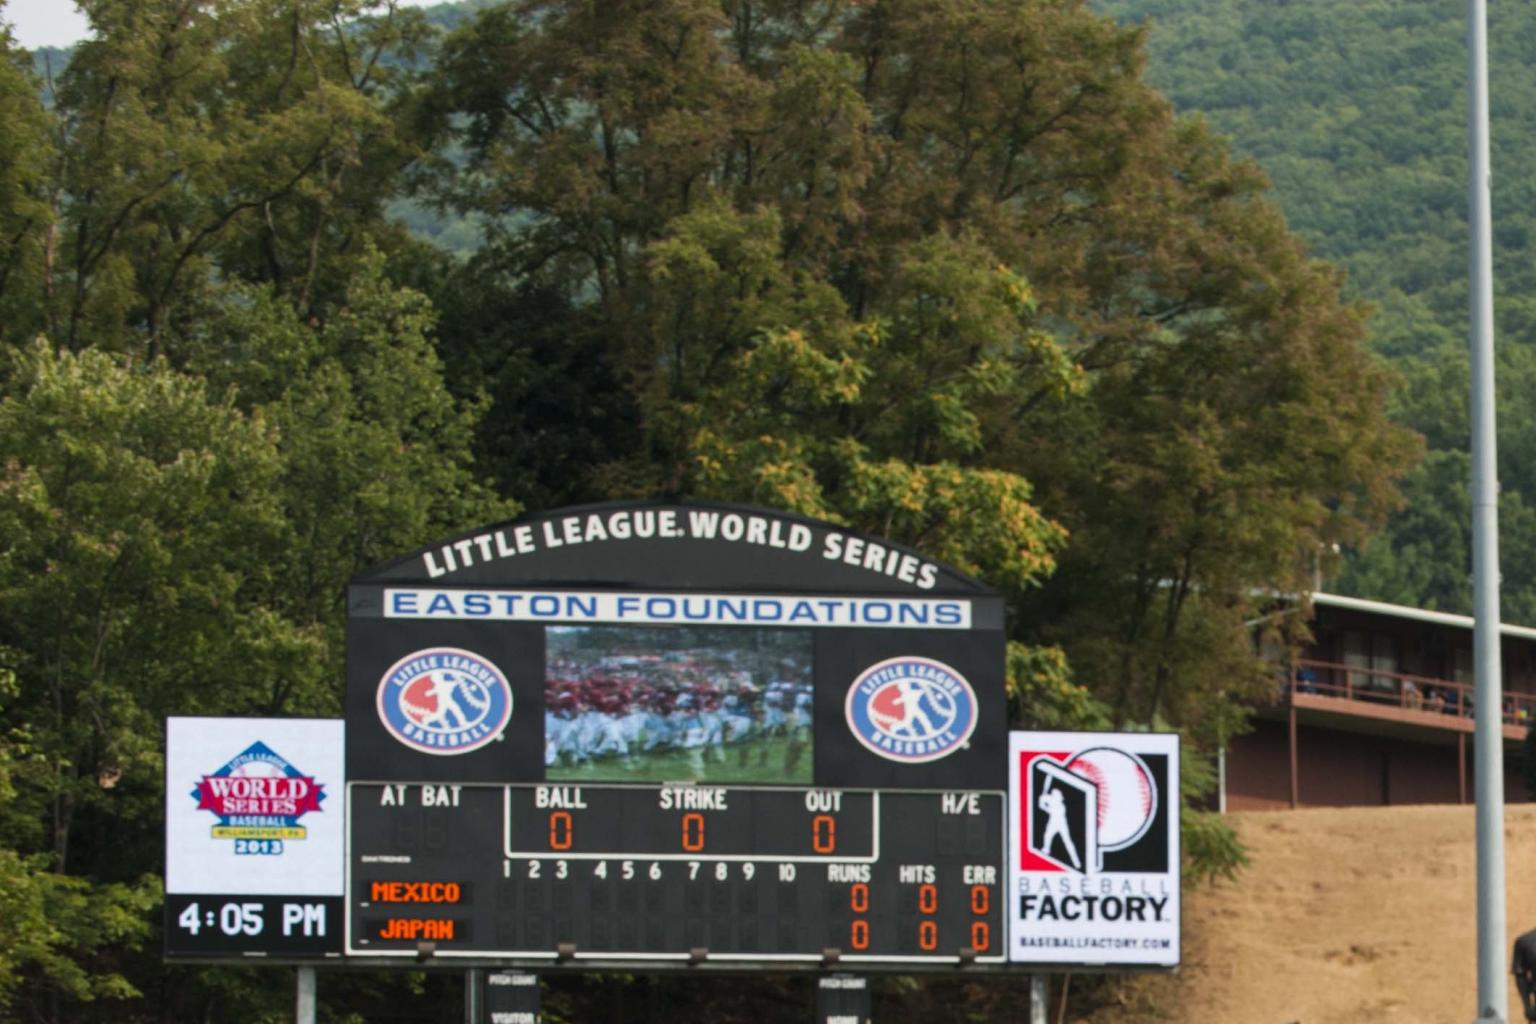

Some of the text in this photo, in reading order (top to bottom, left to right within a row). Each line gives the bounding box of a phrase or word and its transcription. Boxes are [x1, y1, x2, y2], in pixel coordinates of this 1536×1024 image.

[422, 510, 939, 590] LITTLE LEAGUE WORLD SERIES
[391, 591, 964, 626] EASTON FOUNDATIONS
[392, 655, 498, 688] LITTLE LEAGUE
[861, 664, 963, 697] LITTLE LEAGUE
[402, 722, 492, 746] BASEBALL
[871, 730, 958, 754] BASEBALL
[208, 777, 308, 800] WORLD
[381, 785, 462, 807] AT BAT
[536, 787, 842, 812] BALL STRIKE OUT
[222, 798, 297, 814] SERIES
[942, 793, 980, 815] H/E
[229, 815, 287, 827] BASEBALL
[550, 811, 573, 850] 0
[682, 812, 704, 852] 0
[813, 815, 836, 853] 0
[236, 839, 282, 854] 2013
[503, 860, 796, 882] 1 2 3 4 5 6 7 8 9 10
[827, 864, 996, 885] RUNS HITS ERR
[371, 882, 460, 903] MEXICO
[850, 883, 989, 915] 0 0 0
[1018, 878, 1170, 896] BASEBALL
[179, 902, 326, 937] 4:05 PM
[1019, 895, 1169, 922] FACTORY
[379, 919, 454, 940] JAPAN
[851, 919, 989, 952] 0 0 0
[1020, 936, 1171, 949] BASEBALLFACTORY.COM
